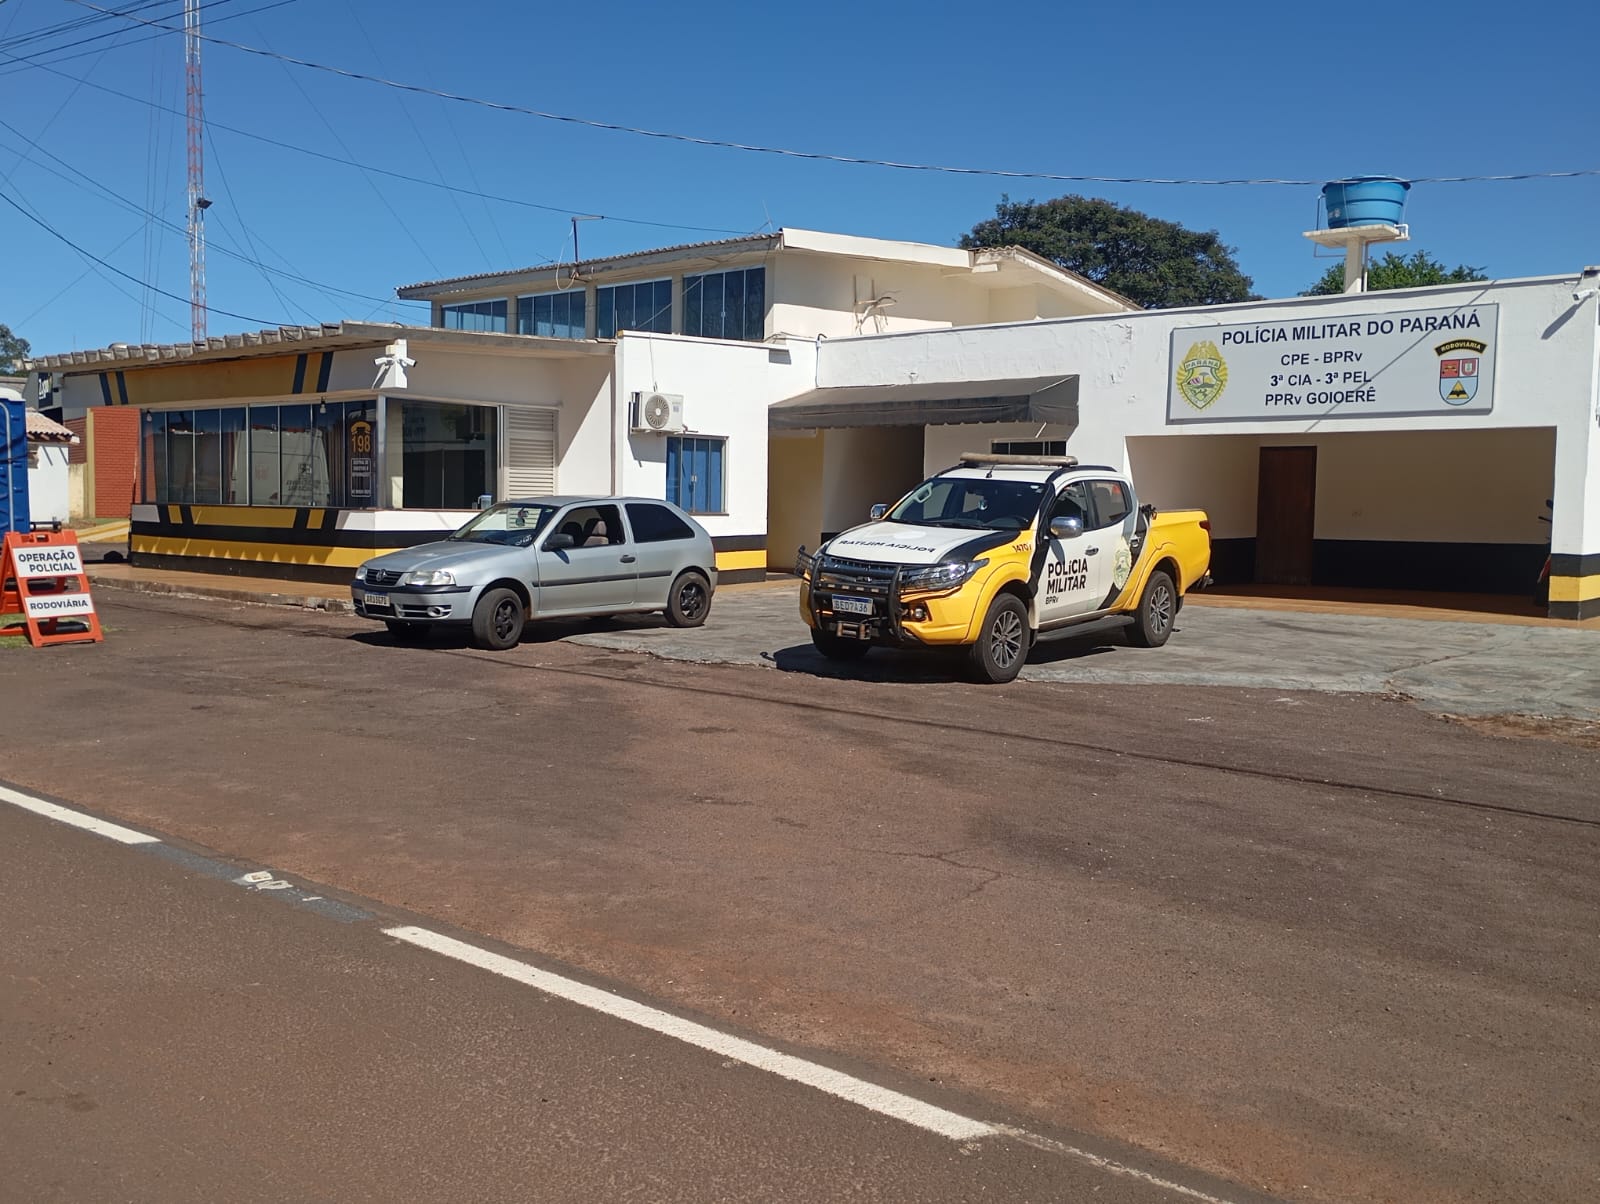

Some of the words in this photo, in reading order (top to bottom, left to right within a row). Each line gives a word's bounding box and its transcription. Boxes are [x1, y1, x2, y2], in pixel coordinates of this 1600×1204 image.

[1222, 326, 1287, 345] POLÍCIA
[1292, 322, 1361, 341] MILITAR
[1367, 319, 1394, 336] DO
[1400, 309, 1480, 333] PARANÁ
[1281, 353, 1310, 366] CPE
[1323, 351, 1363, 364] BPRv
[1288, 374, 1312, 386] CIA
[1343, 371, 1372, 384] PEL
[1265, 393, 1302, 406] PPRv
[1306, 386, 1376, 405] GOIOERÊ
[351, 435, 371, 453] 198
[18, 549, 76, 563] OPERAÇÃO
[29, 562, 77, 573] POLICIAL
[1046, 575, 1086, 595] MILITAR
[30, 599, 89, 610] RODOVIÁRIA
